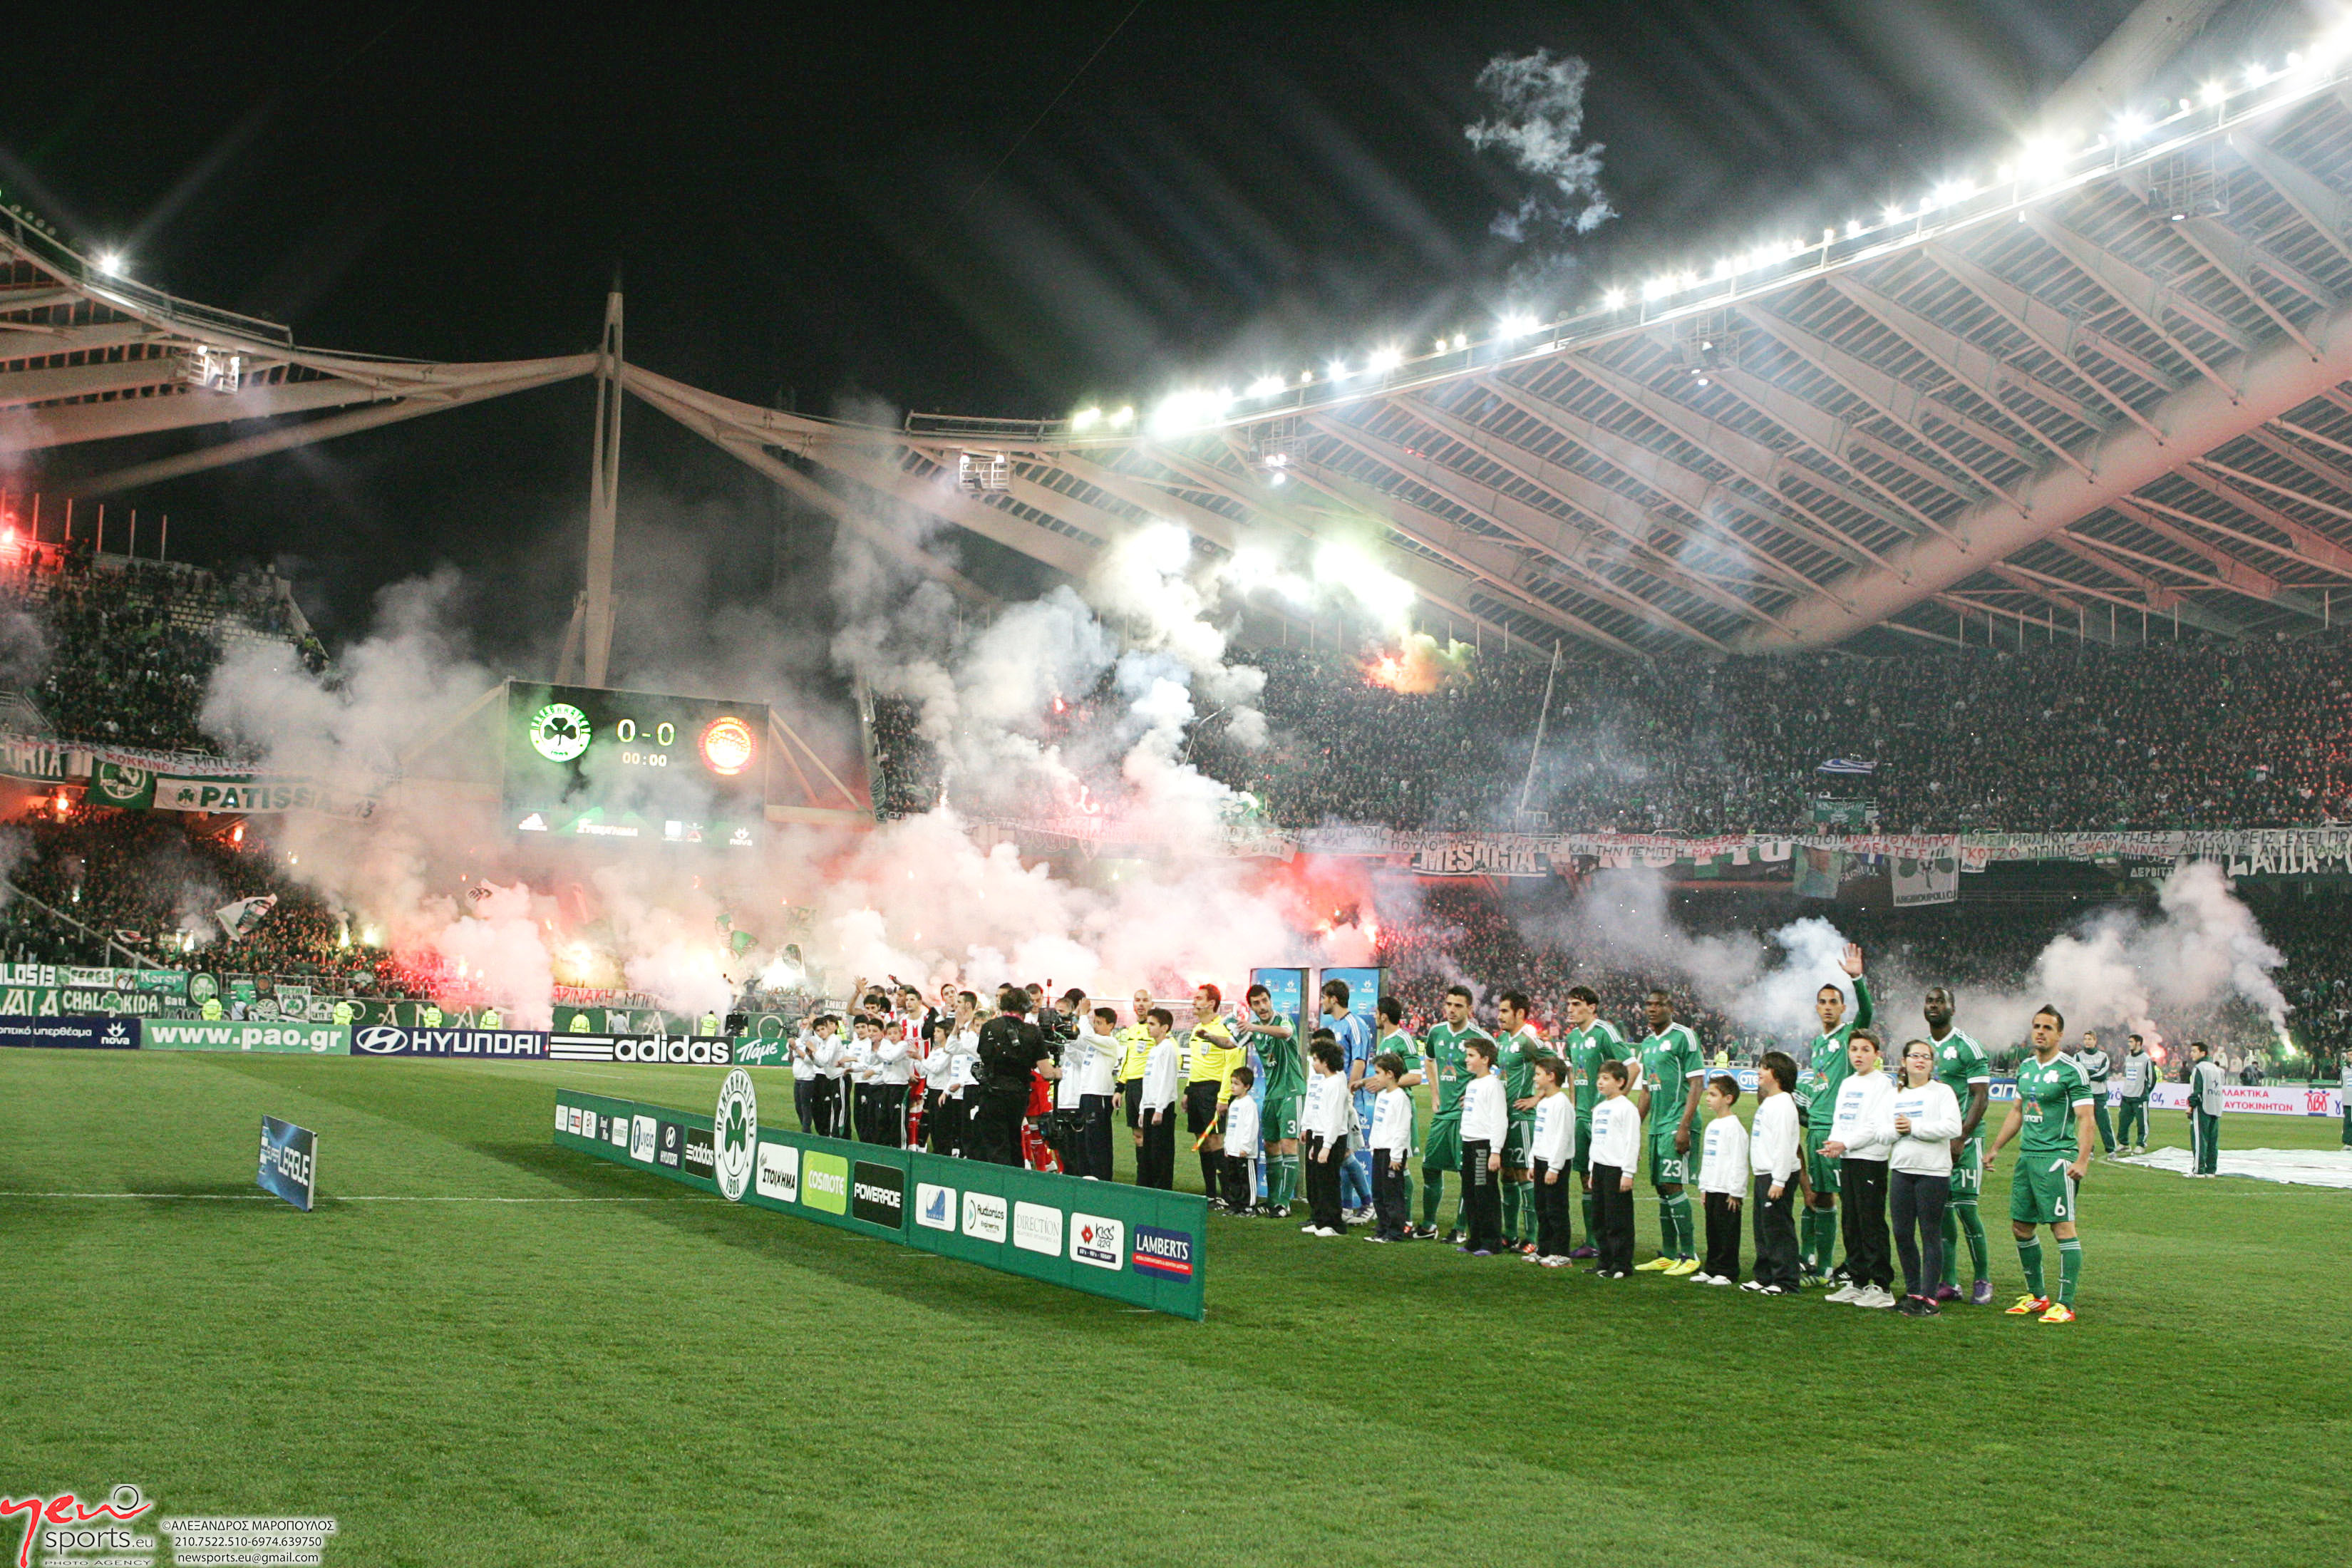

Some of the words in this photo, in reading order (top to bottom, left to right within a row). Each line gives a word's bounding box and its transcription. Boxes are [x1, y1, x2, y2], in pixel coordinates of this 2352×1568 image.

[622, 752, 667, 767] 00:00
[33, 1026, 92, 1037] υπερθέαμα
[101, 1036, 130, 1045] nova
[151, 1026, 342, 1053] www.pao.gr
[413, 1031, 540, 1055] HYUNDAI
[614, 1034, 730, 1063] adidas
[736, 1038, 778, 1065] Πάμε
[2224, 1101, 2293, 1112] ΑΥΤΟΚΙΝΗΤΩΝ
[1287, 1120, 1296, 1135] 3
[693, 1142, 713, 1166] adidas
[1662, 1160, 1682, 1177] 23
[1960, 1169, 1984, 1188] 14
[726, 1175, 739, 1196] 1908
[808, 1170, 845, 1196] COSMOTE
[854, 1182, 901, 1208] POWERADE
[2054, 1197, 2066, 1217] 6
[1136, 1234, 1189, 1261] LAMBERTS
